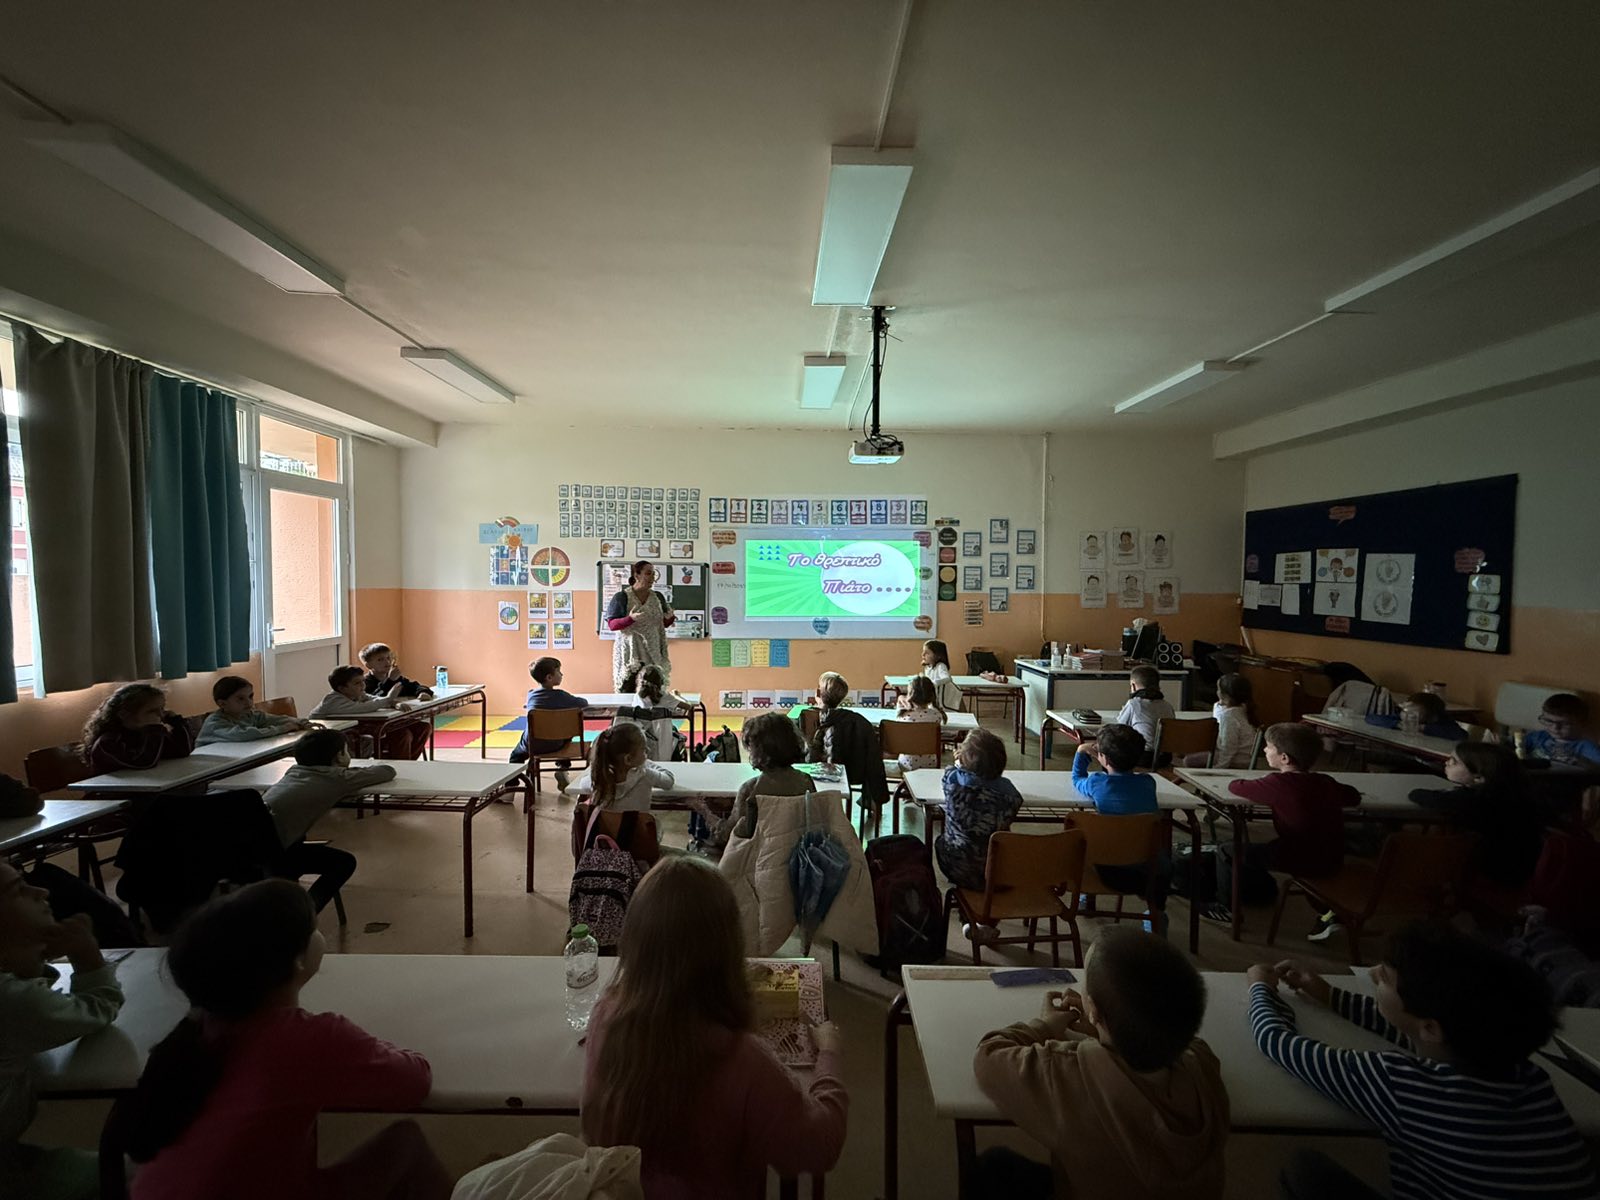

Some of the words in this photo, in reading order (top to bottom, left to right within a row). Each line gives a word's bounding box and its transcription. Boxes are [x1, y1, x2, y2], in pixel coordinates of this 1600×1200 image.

[788, 553, 811, 567] Το
[814, 552, 881, 569] θρεπτικό
[823, 579, 872, 593] Πιάτο
